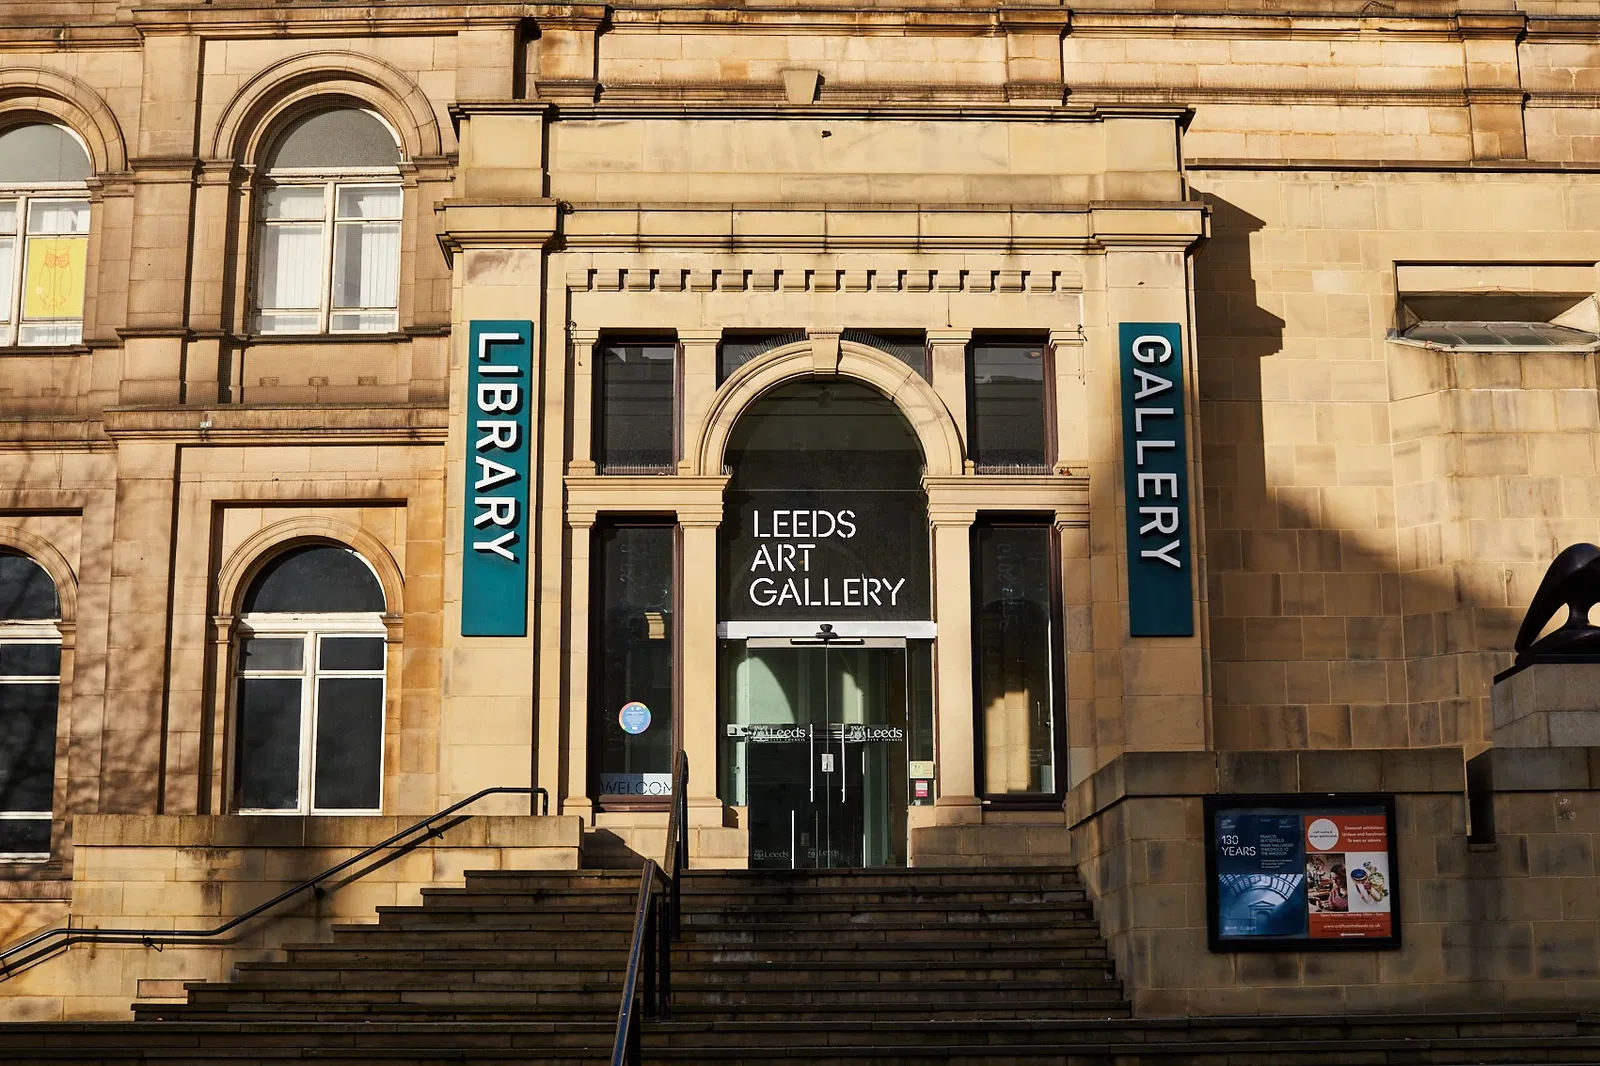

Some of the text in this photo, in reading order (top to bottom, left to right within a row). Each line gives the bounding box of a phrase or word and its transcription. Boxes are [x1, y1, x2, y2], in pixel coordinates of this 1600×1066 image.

[473, 332, 520, 561] LIBRARY
[1132, 335, 1180, 568] GALLERY
[754, 510, 856, 538] LEEDS
[750, 544, 816, 572] ART
[750, 577, 906, 606] GALLERY
[770, 727, 806, 738] Leeds
[867, 727, 903, 738] Leeds
[600, 782, 672, 795] WELCOM
[1221, 835, 1238, 844] 130
[1221, 846, 1256, 856] YEARS
